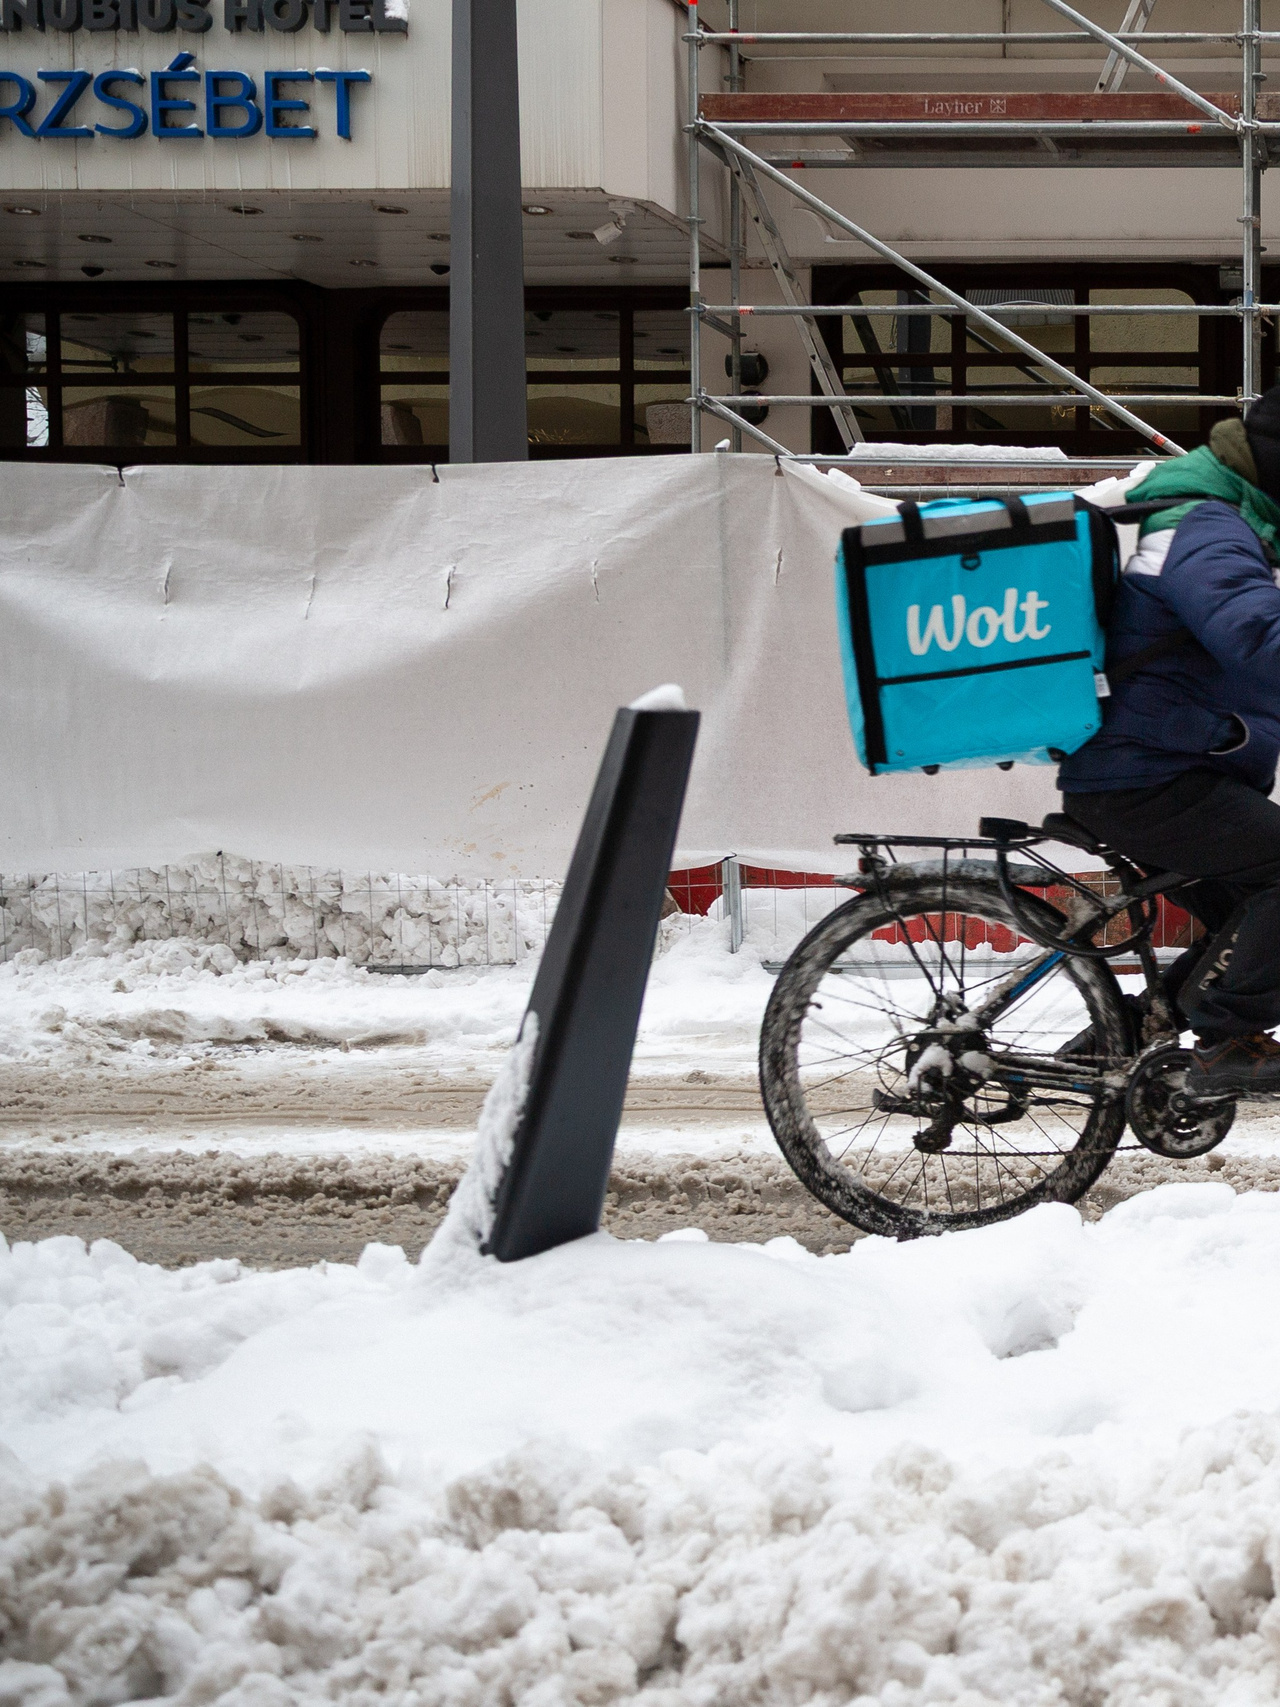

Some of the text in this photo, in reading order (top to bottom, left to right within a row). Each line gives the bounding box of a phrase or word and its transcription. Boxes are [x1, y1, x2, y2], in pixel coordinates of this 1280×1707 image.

[224, 0, 409, 33] HOTEL
[0, 50, 372, 139] RZSÉBET
[924, 98, 983, 116] Layher
[907, 587, 1052, 656] Wolt
